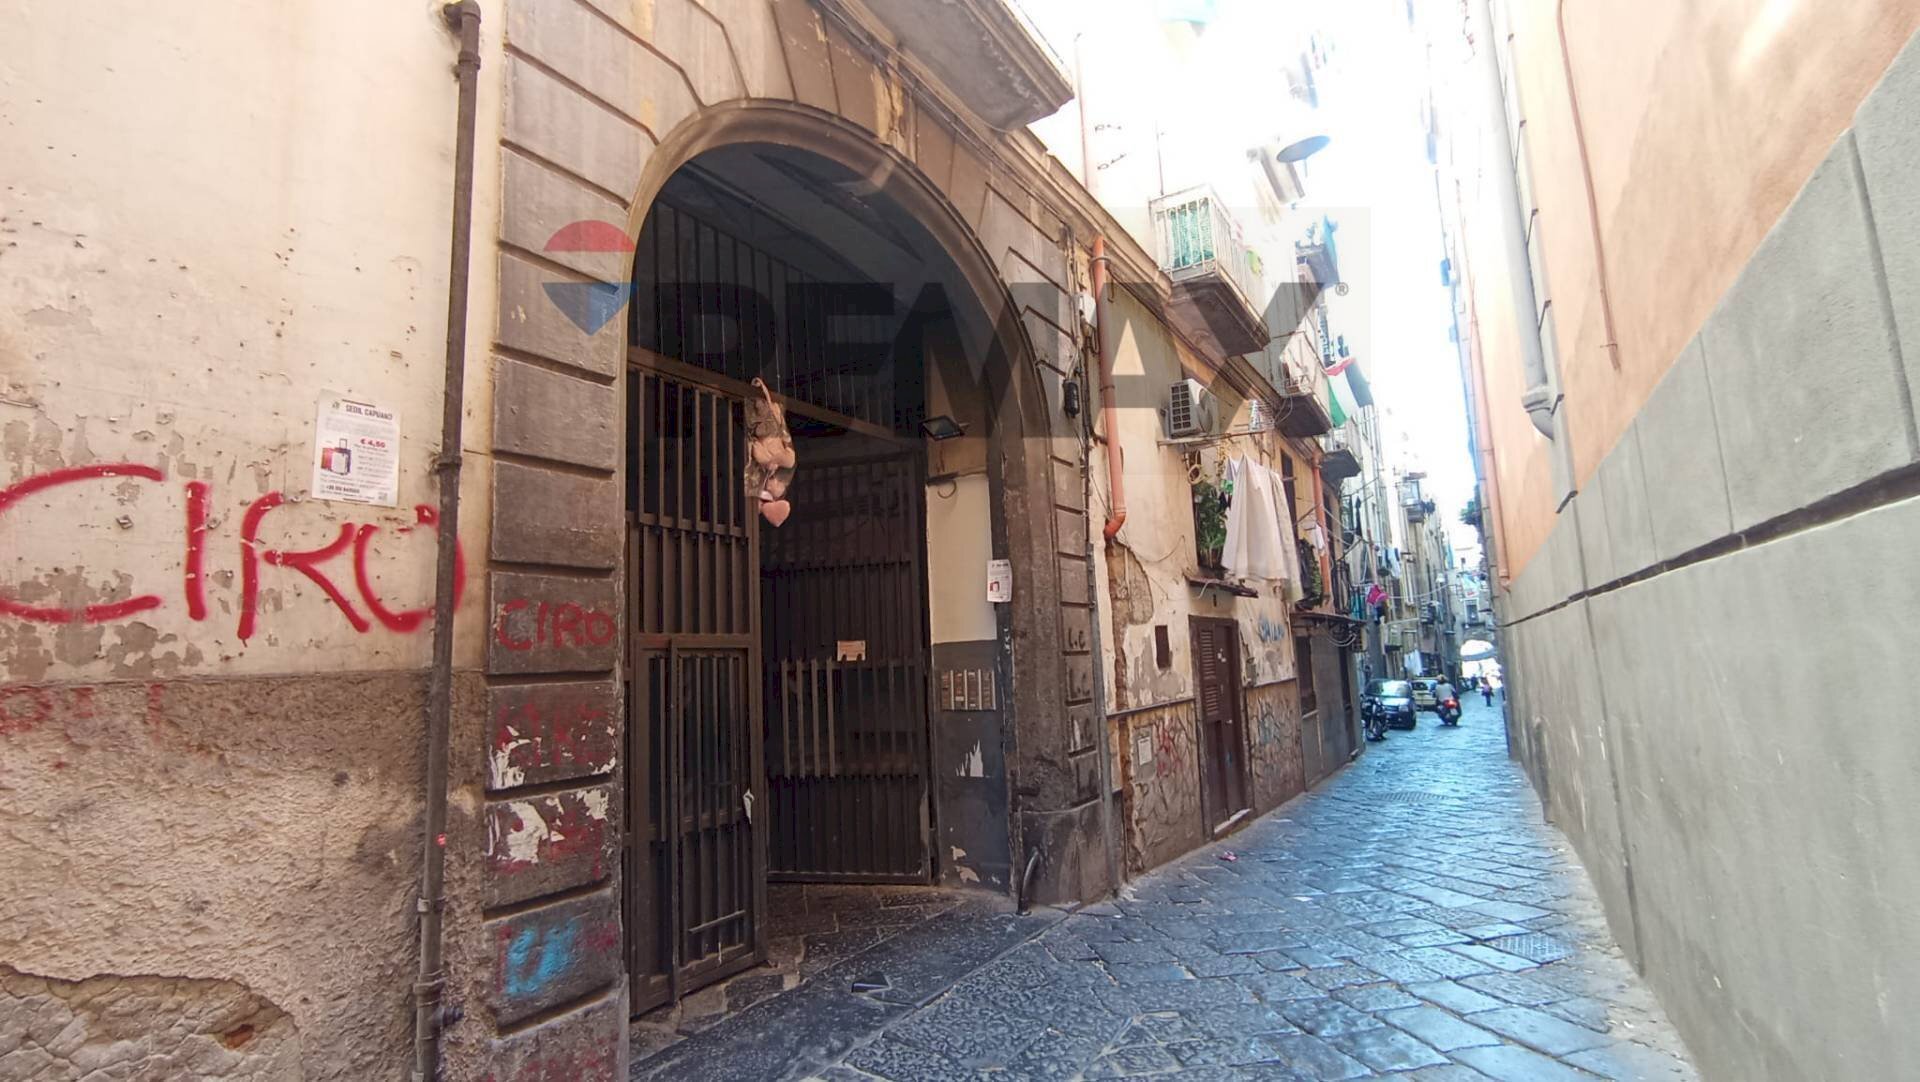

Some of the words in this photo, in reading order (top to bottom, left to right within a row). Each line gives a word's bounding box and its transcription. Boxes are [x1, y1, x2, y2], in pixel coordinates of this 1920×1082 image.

[364, 408, 393, 420] CAPUANO
[0, 464, 466, 640] CIRO
[496, 600, 616, 652] CIRO
